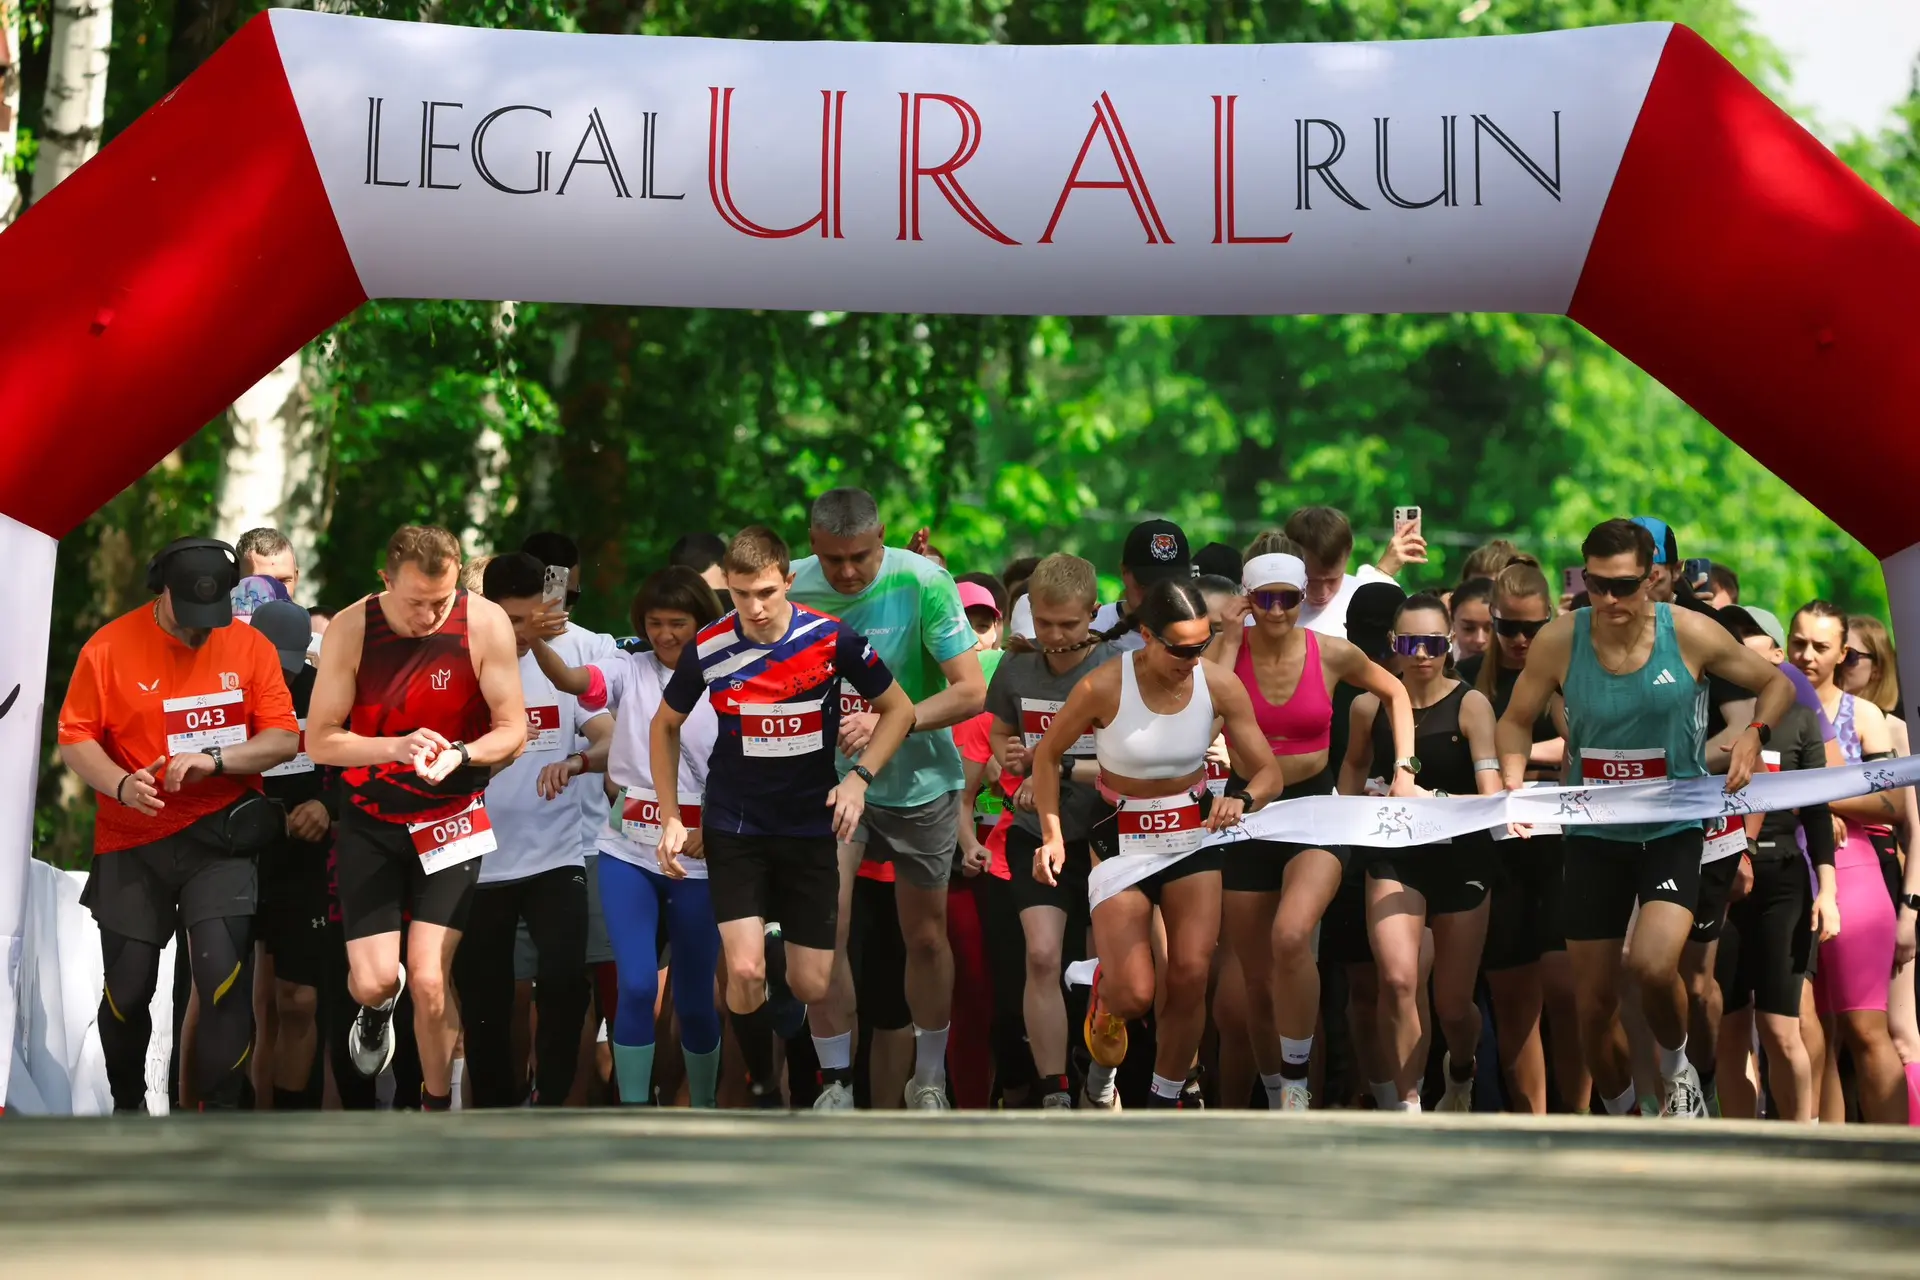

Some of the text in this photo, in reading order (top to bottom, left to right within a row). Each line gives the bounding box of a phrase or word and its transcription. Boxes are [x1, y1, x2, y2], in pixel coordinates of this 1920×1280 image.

[364, 86, 1562, 246] LEGAL URAL RUN
[186, 708, 226, 729] 043
[761, 717, 802, 735] 019
[1602, 762, 1645, 778] 053
[432, 816, 473, 843] 098
[1139, 811, 1181, 831] 052
